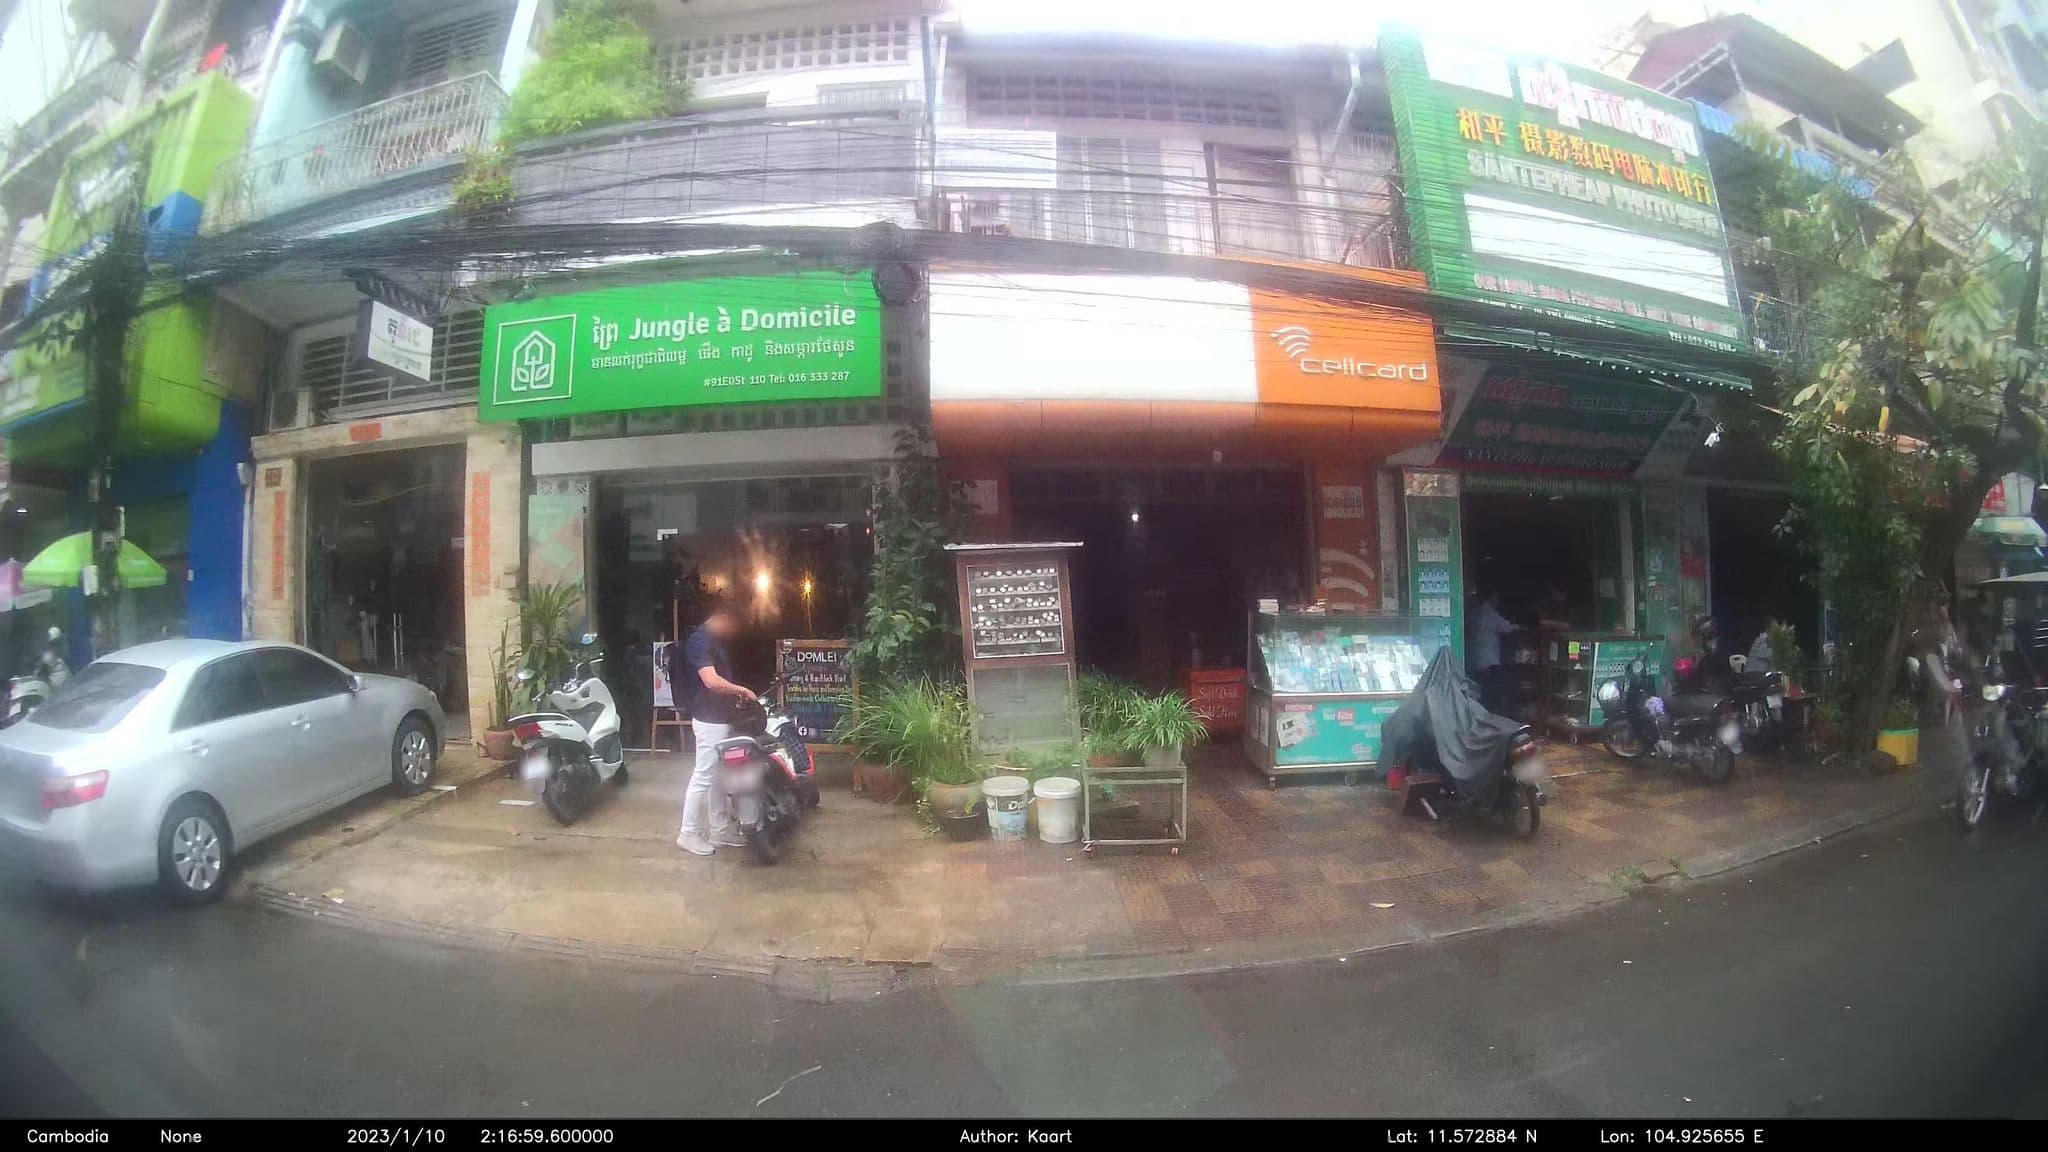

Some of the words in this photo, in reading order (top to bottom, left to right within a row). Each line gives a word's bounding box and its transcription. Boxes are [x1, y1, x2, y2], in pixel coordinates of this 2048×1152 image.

[1456, 107, 1508, 146] 和平
[628, 312, 710, 342] Jungle
[716, 306, 731, 333] à
[741, 303, 856, 332] Domicile
[749, 374, 766, 385] 110
[788, 372, 807, 383] 016
[810, 371, 829, 382] 333
[832, 370, 850, 381] 287
[1300, 357, 1428, 382] cellcard
